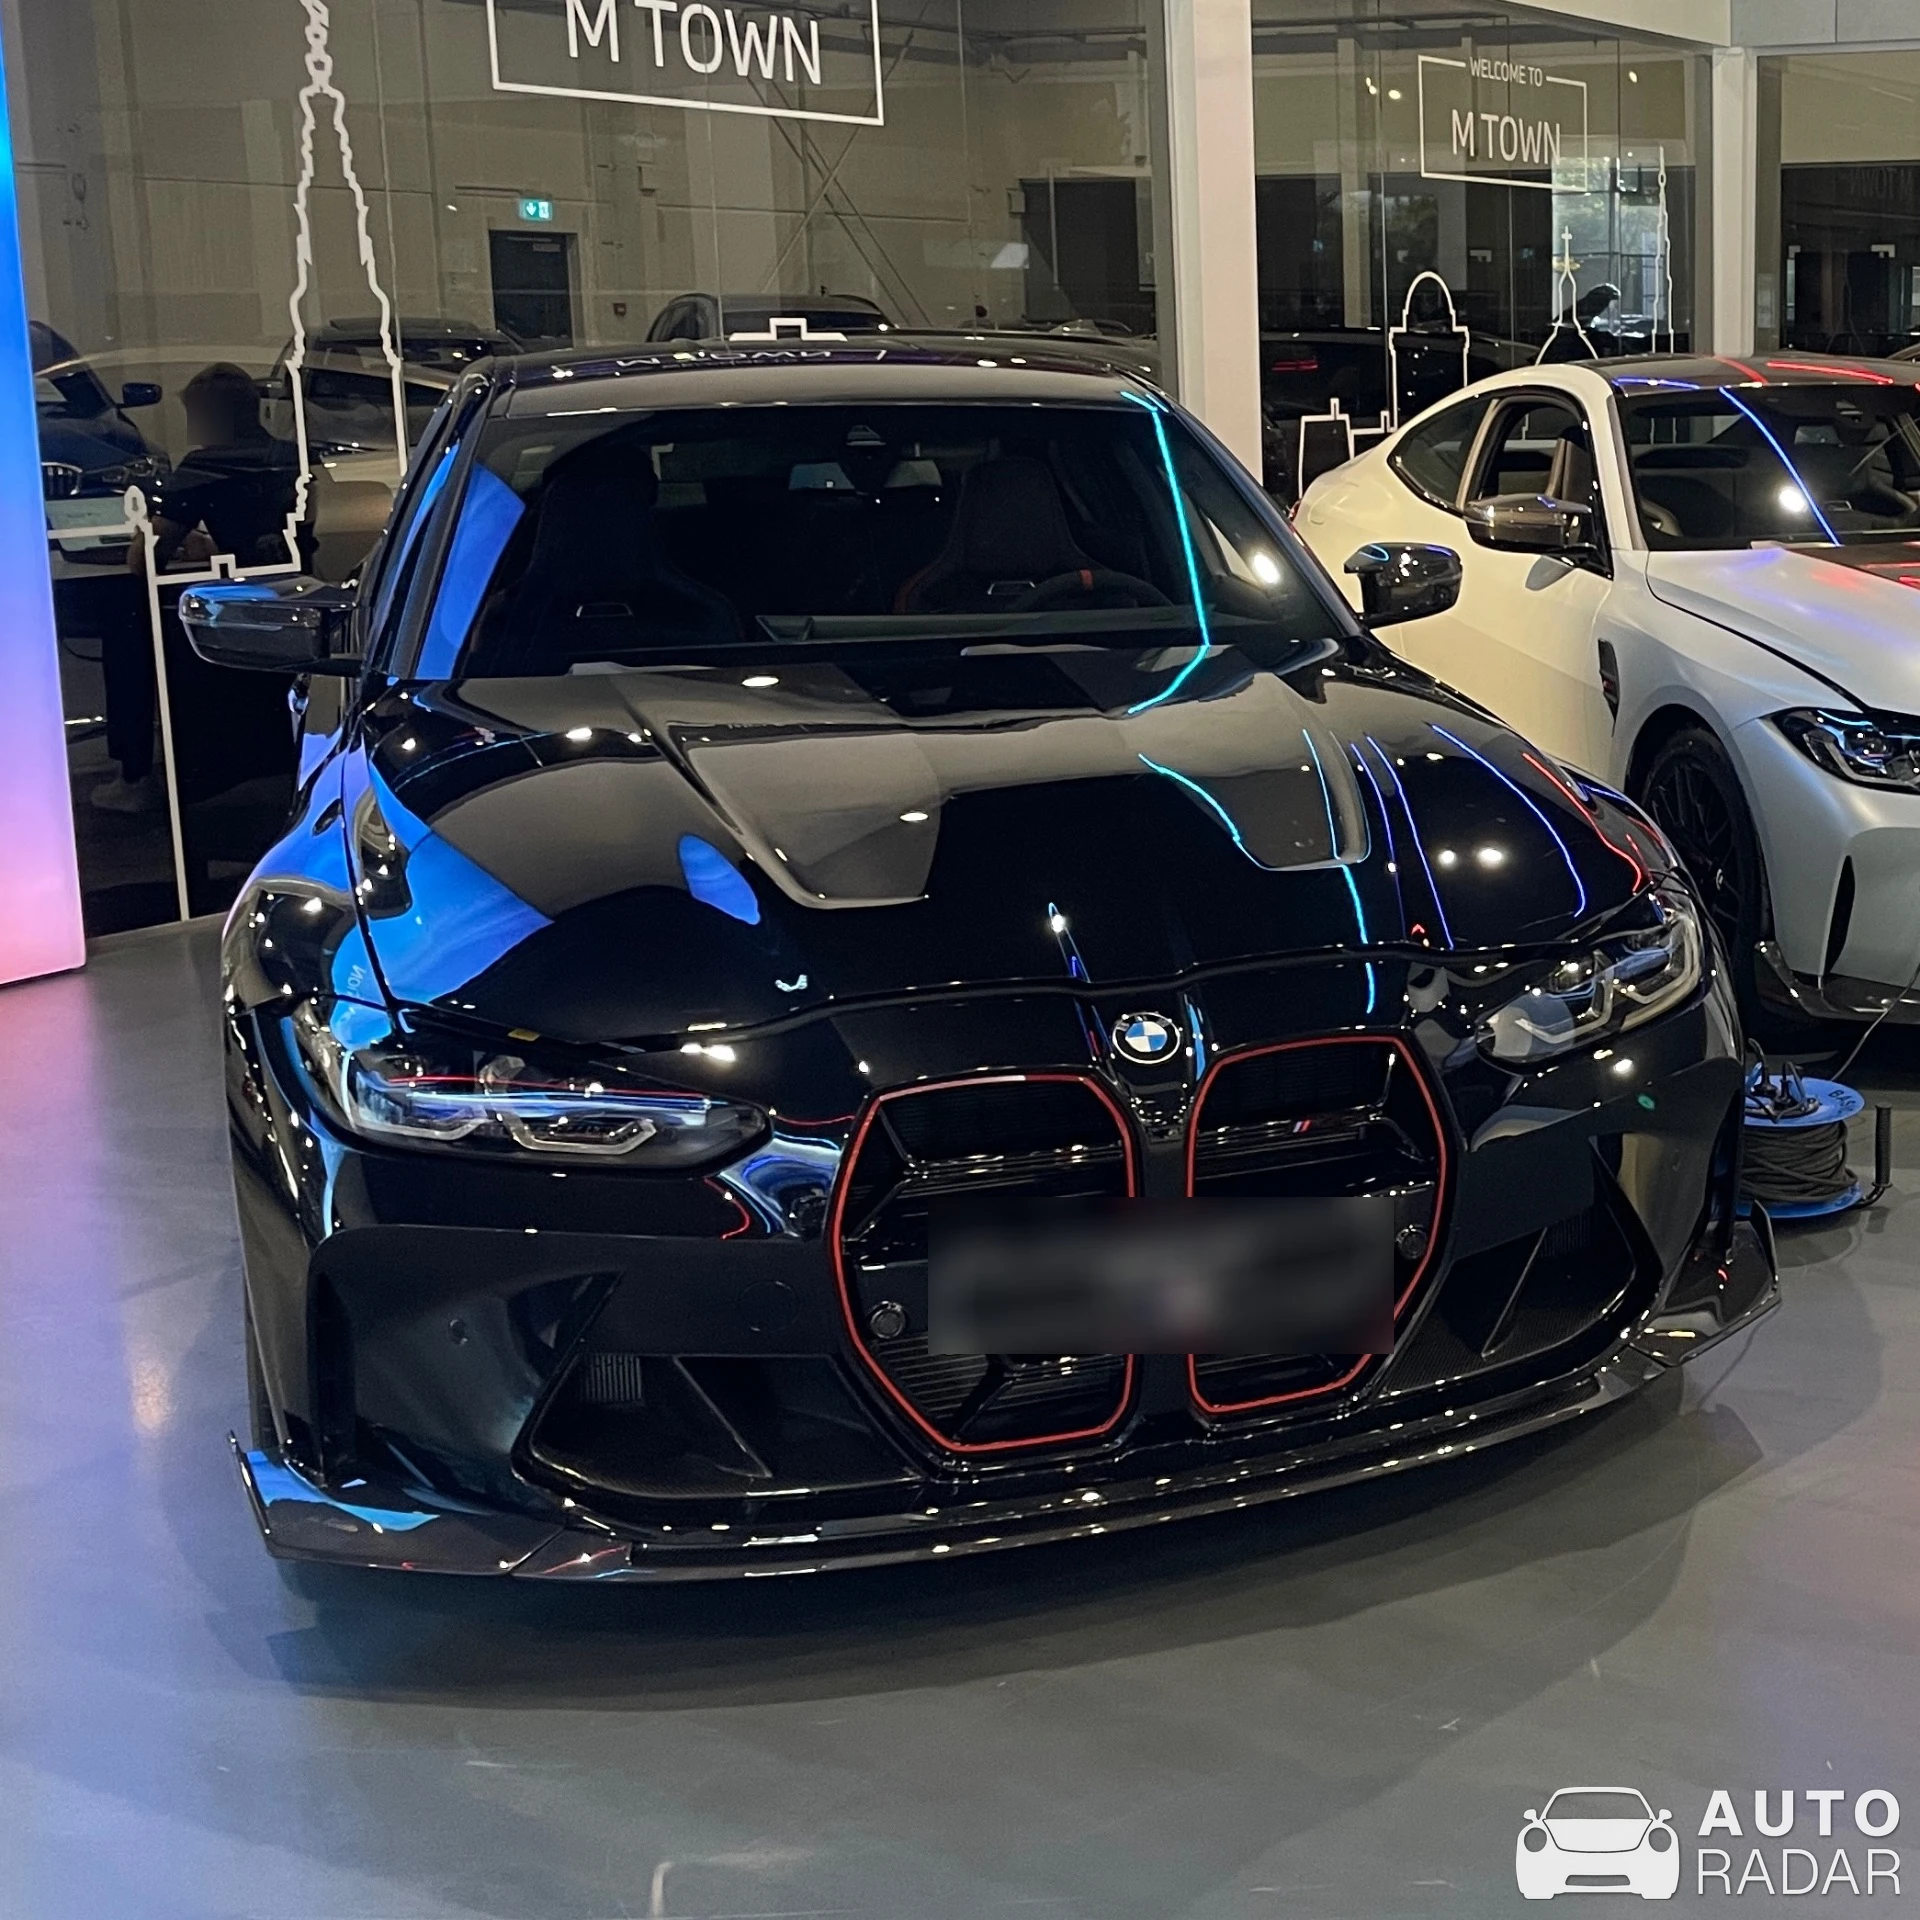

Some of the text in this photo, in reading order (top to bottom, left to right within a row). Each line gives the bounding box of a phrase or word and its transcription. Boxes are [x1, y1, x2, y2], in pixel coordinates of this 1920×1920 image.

[564, 0, 822, 85] M TOWN
[1469, 56, 1543, 87] WELCOME TO
[1452, 109, 1561, 165] M TOWN
